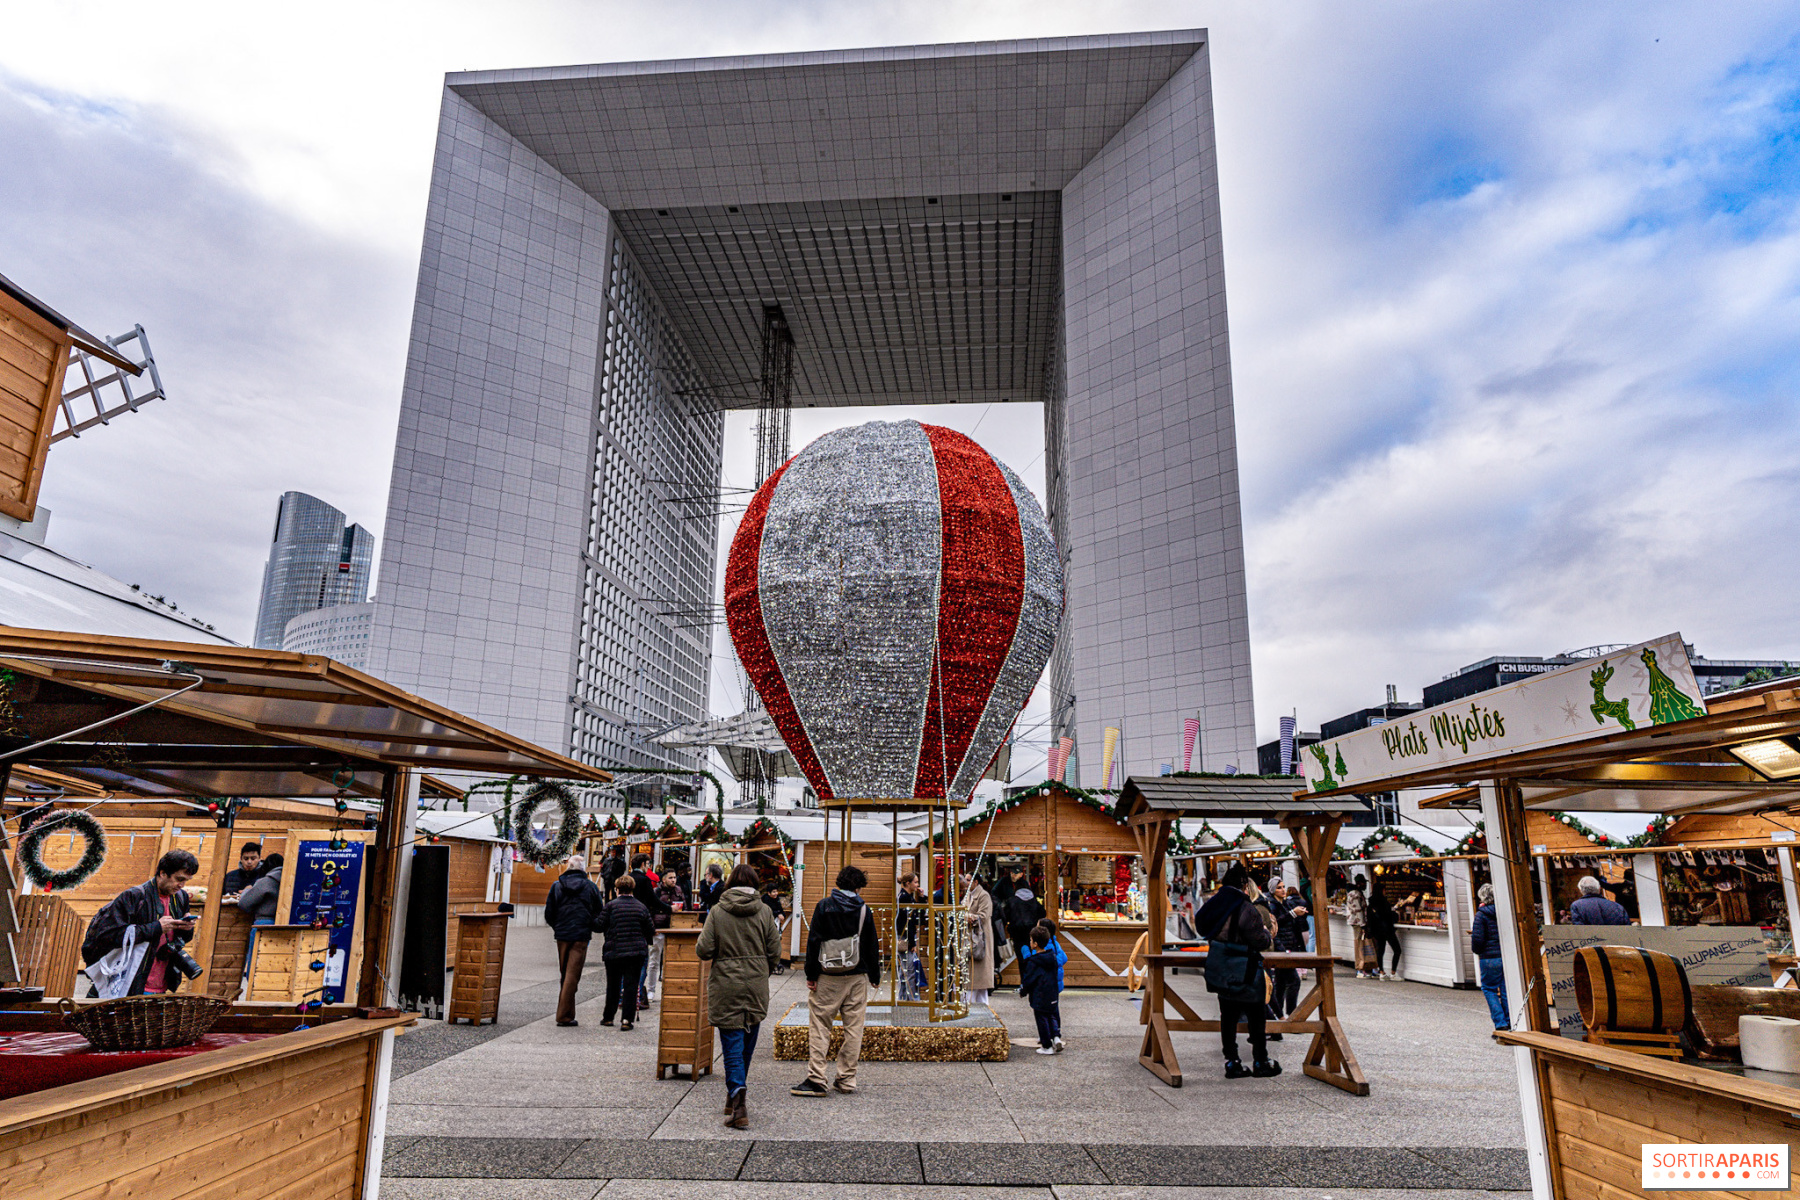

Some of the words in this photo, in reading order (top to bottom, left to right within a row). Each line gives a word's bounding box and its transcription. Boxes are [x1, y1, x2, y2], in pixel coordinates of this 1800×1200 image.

[1498, 664, 1516, 672] ICN
[1382, 721, 1428, 760] Plats
[1430, 702, 1505, 754] Mijotés
[1580, 936, 1598, 947] GLOSS
[1682, 942, 1737, 968] ALUPANEL
[1737, 937, 1756, 948] GLOSS
